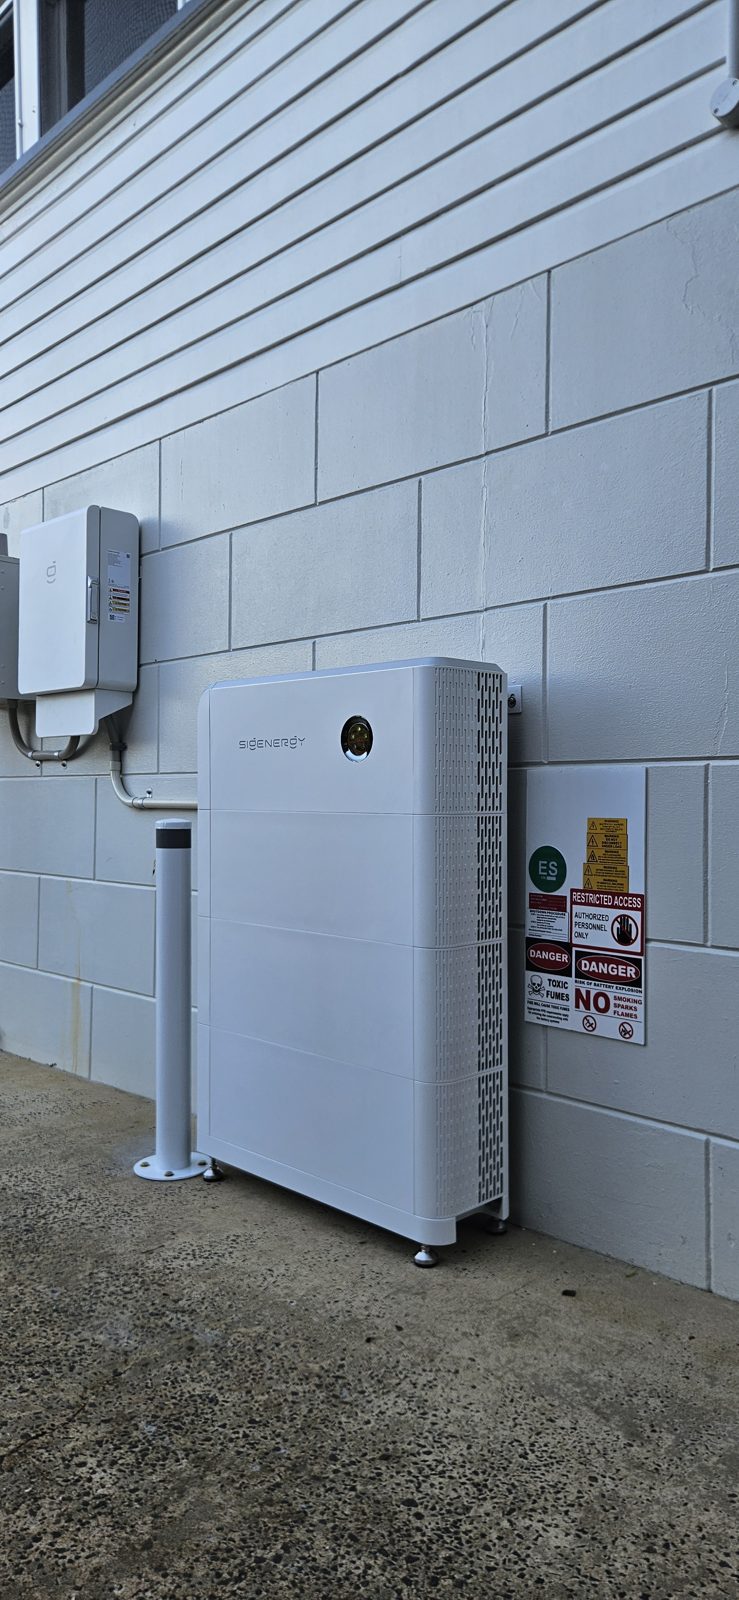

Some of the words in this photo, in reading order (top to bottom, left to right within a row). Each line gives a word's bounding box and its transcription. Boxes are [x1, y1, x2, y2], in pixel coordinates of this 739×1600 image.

[538, 860, 558, 876] ES
[572, 892, 613, 905] RESTRICTED
[613, 896, 642, 908] ACCESS
[574, 912, 610, 922] AUTHORIZED
[574, 921, 608, 932] PERSONNEL
[574, 931, 589, 939] ONLY
[529, 949, 569, 963] DANGER
[581, 960, 636, 978] DANGER
[547, 978, 569, 989] TOXIC
[593, 982, 615, 990] BATTERY
[615, 985, 643, 994] EXPLOSION
[546, 990, 570, 1002] FUMES
[574, 987, 611, 1014] NO
[613, 995, 643, 1005] SMOKING
[613, 1002, 638, 1012] SPARKS
[613, 1010, 638, 1019] FLAMES
